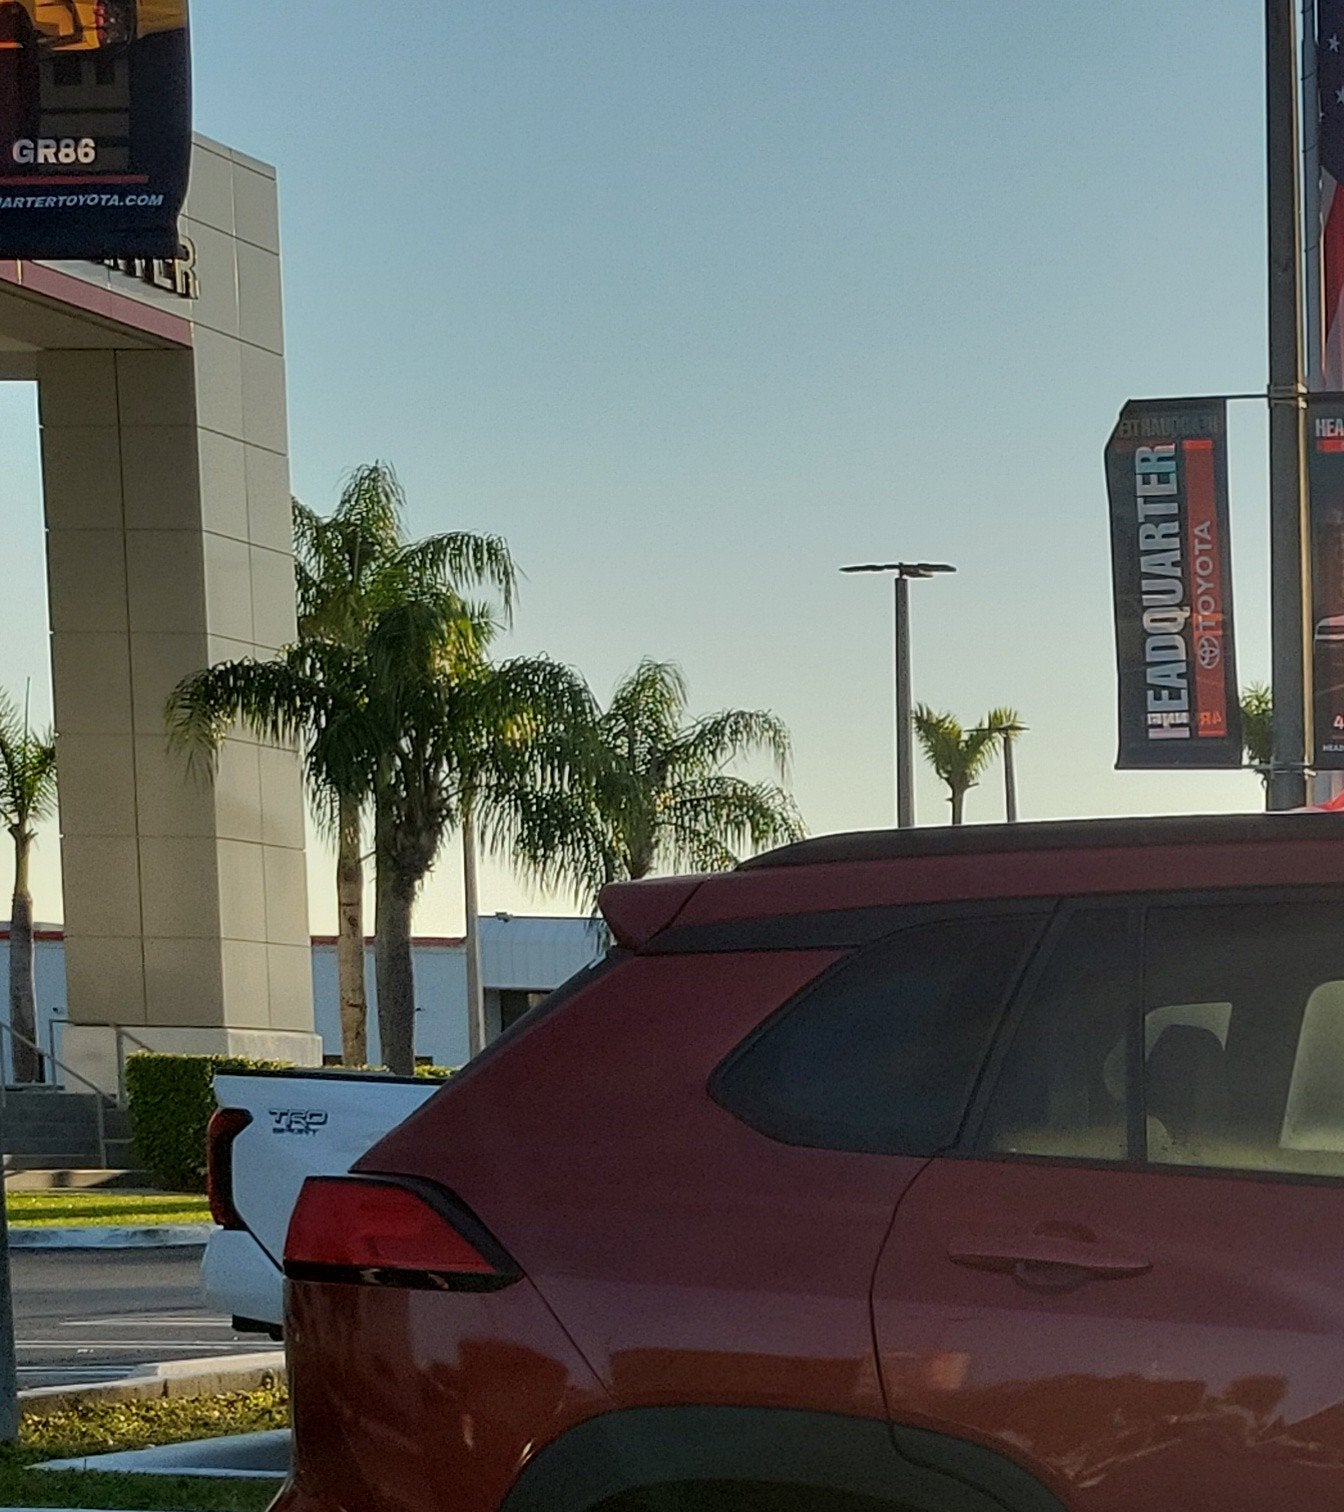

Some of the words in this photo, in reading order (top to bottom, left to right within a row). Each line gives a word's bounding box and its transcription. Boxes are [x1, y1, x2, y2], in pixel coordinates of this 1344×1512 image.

[13, 138, 96, 164] GR86
[0, 194, 164, 209] ARTERTOYOTA.COM
[1194, 520, 1217, 632] TOYOTA
[1135, 443, 1191, 740] HEADQUARTER
[269, 1109, 328, 1130] TRD
